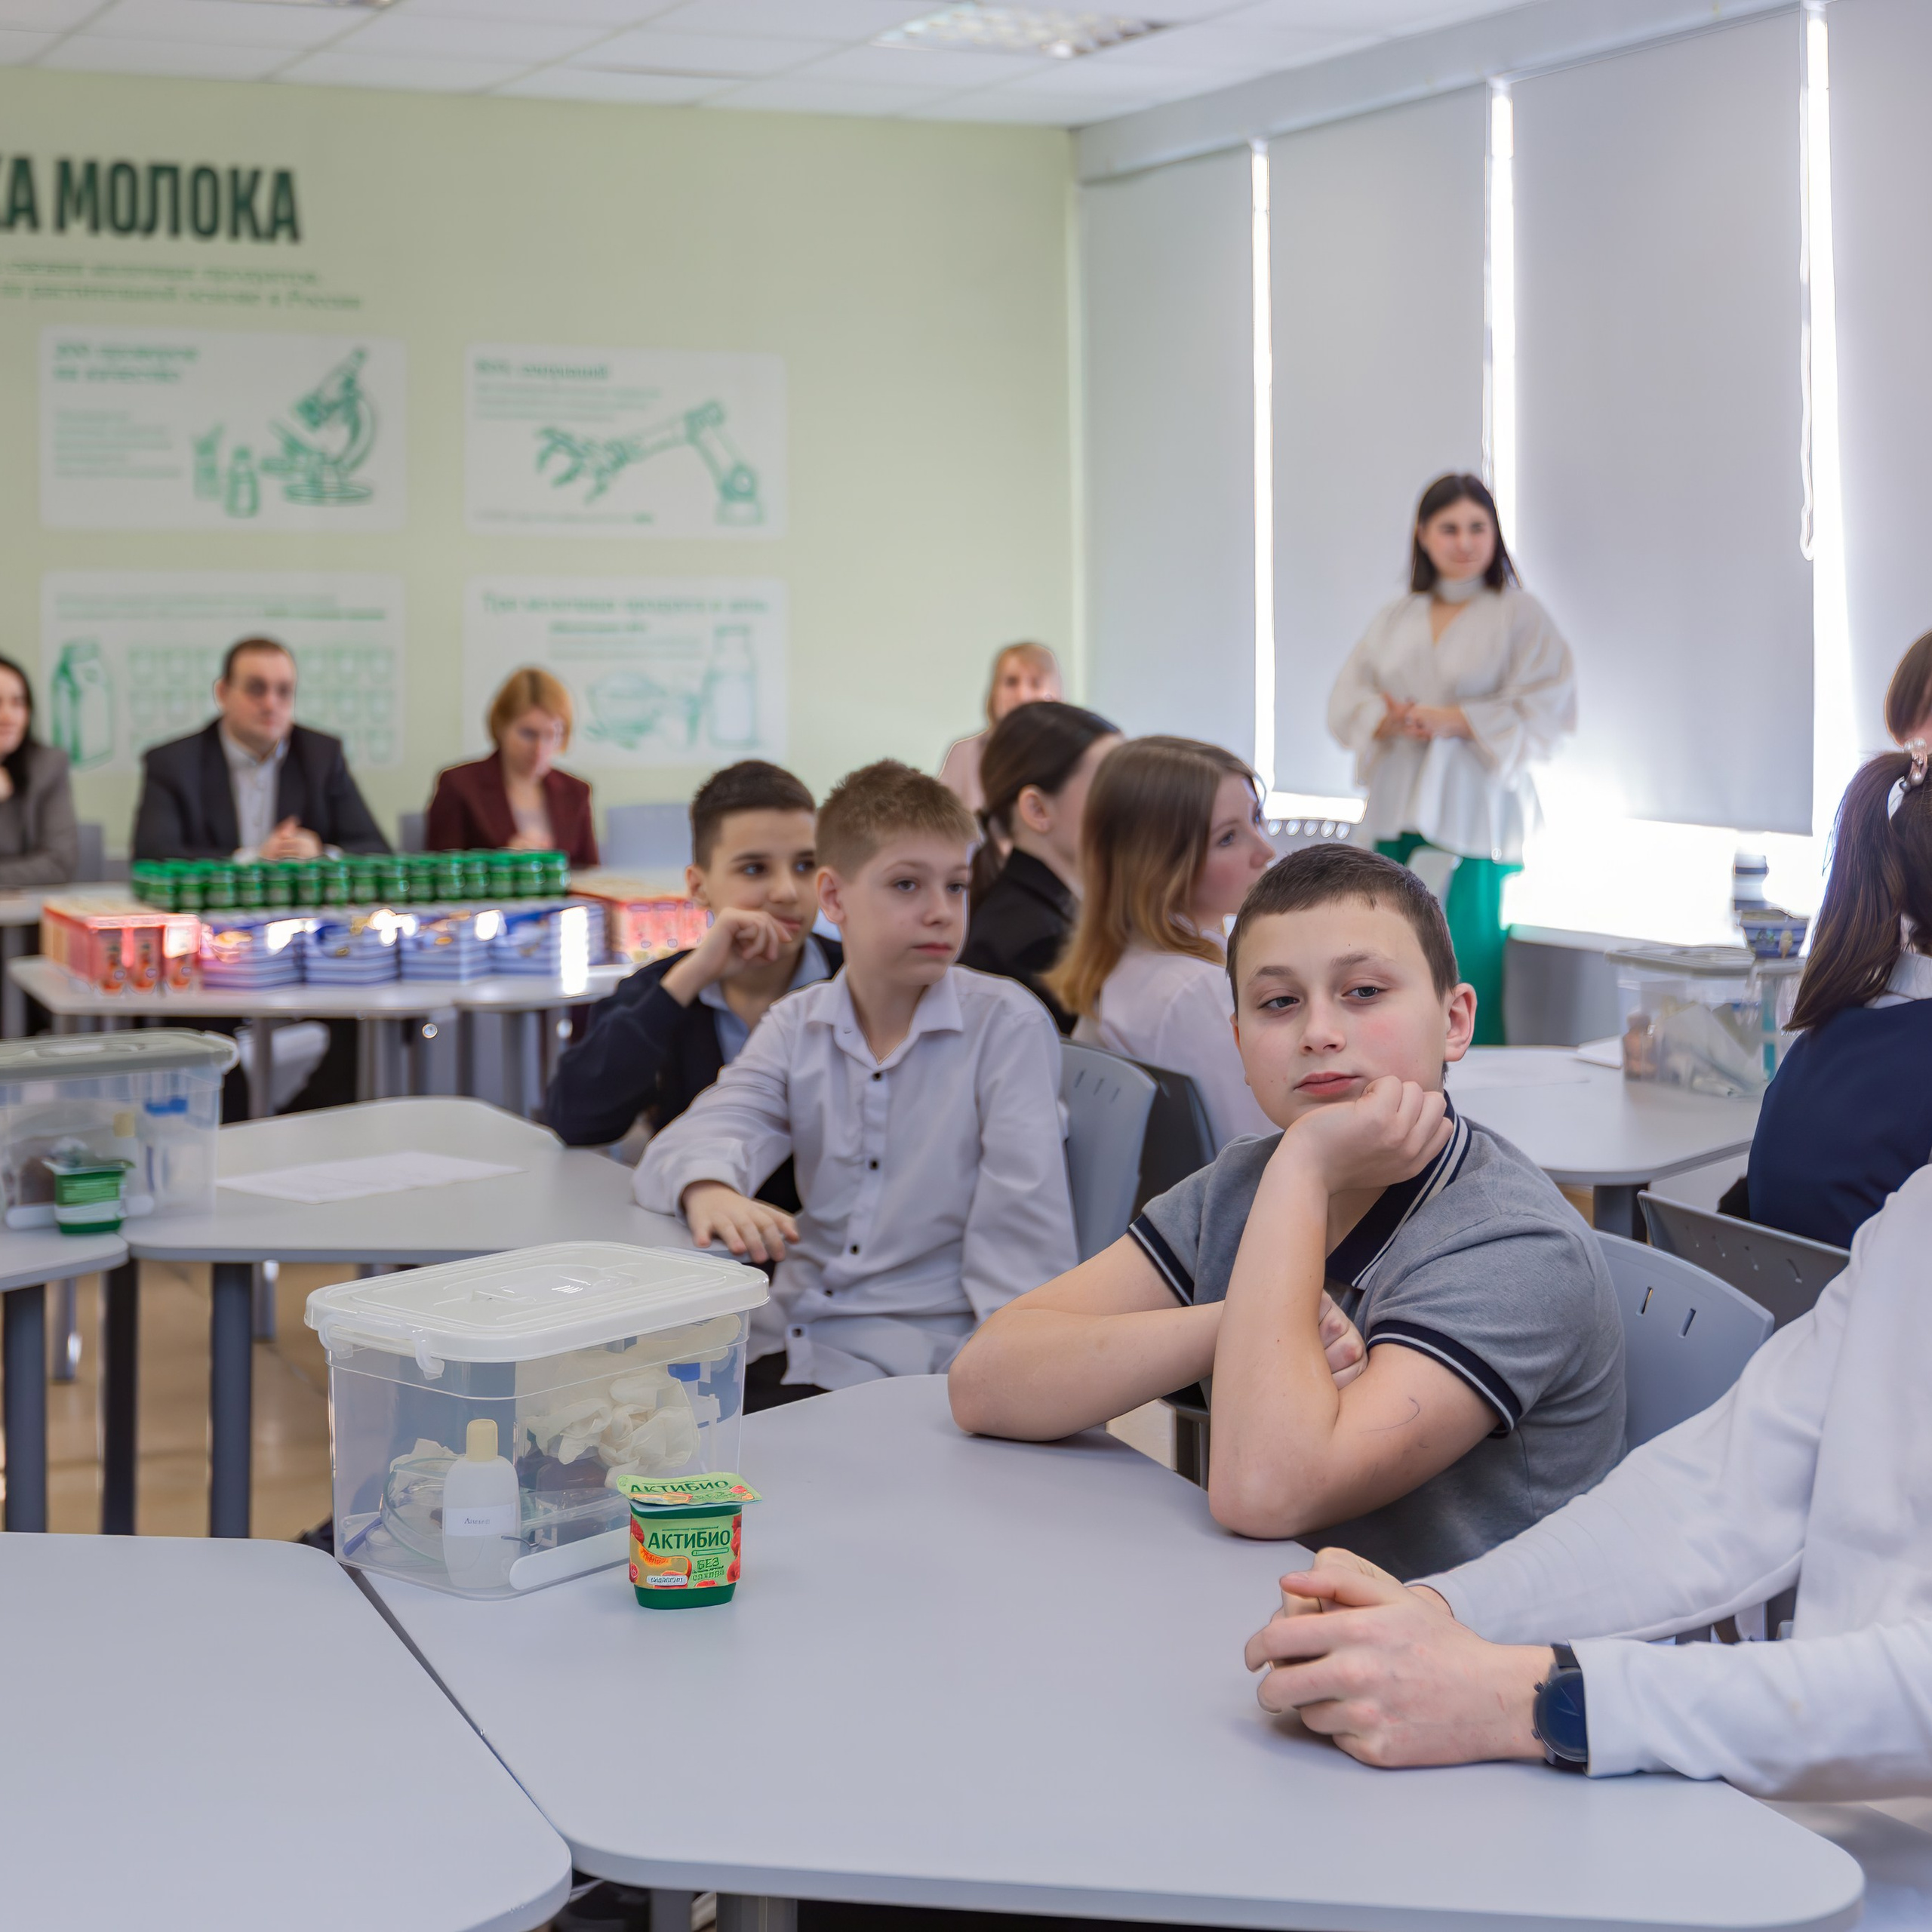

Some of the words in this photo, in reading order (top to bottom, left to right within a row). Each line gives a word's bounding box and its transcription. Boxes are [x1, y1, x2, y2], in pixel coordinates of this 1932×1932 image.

[55, 158, 303, 245] МОЛОКА
[630, 1480, 729, 1493] АКТИБИО
[648, 1530, 731, 1549] АКТИБИО
[697, 1557, 720, 1571] БЕЗ
